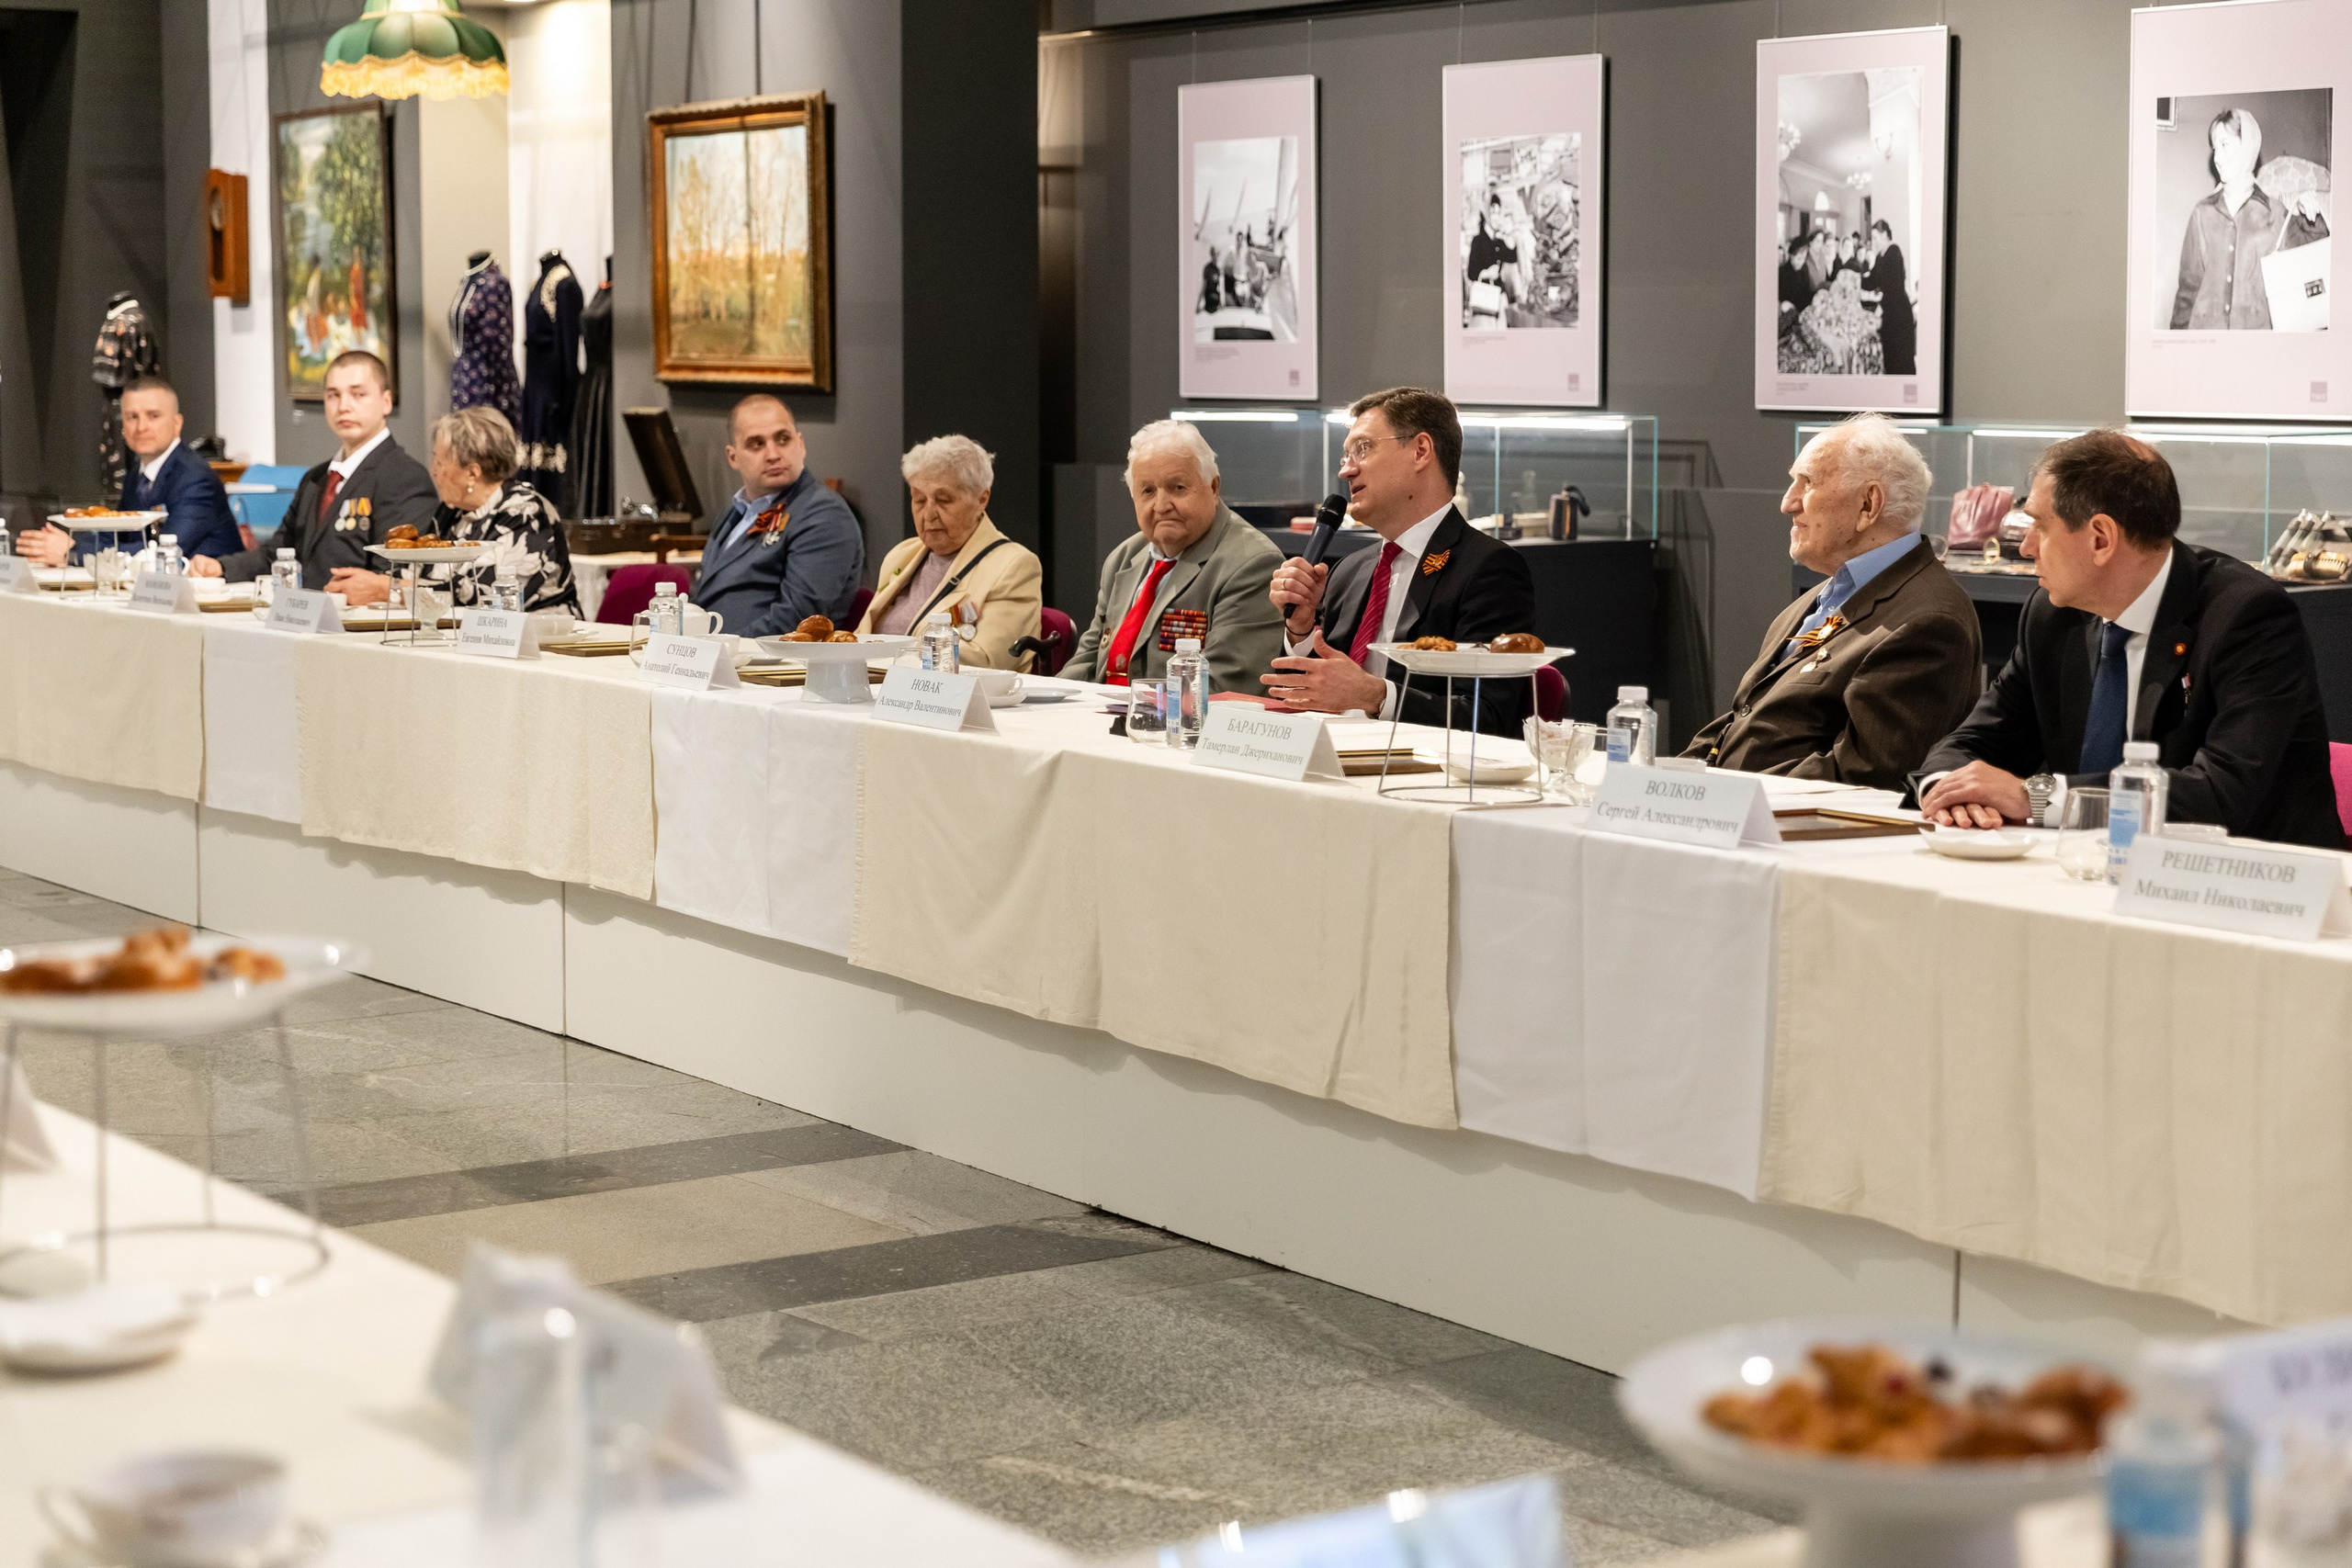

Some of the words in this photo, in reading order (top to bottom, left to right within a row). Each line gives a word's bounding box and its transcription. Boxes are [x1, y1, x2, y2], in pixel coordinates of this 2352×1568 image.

[666, 643, 697, 658] СУНЦОВ
[642, 660, 671, 674] Анатолий
[910, 678, 944, 694] НОВАК
[878, 695, 914, 712] Александр
[914, 699, 962, 717] Валентинович
[1227, 718, 1293, 740] БАРАГУНОВ
[1202, 737, 1240, 754] Тамерлан
[1240, 743, 1304, 765] Джериханович
[1645, 780, 1706, 801] ВОЛКОВ
[1597, 801, 1640, 821] Сергей
[1641, 807, 1739, 833] Александрович
[2161, 850, 2297, 884] РЕШЕТНИКОВ
[2133, 878, 2199, 904] Михаил
[2203, 886, 2307, 918] Николаевич
